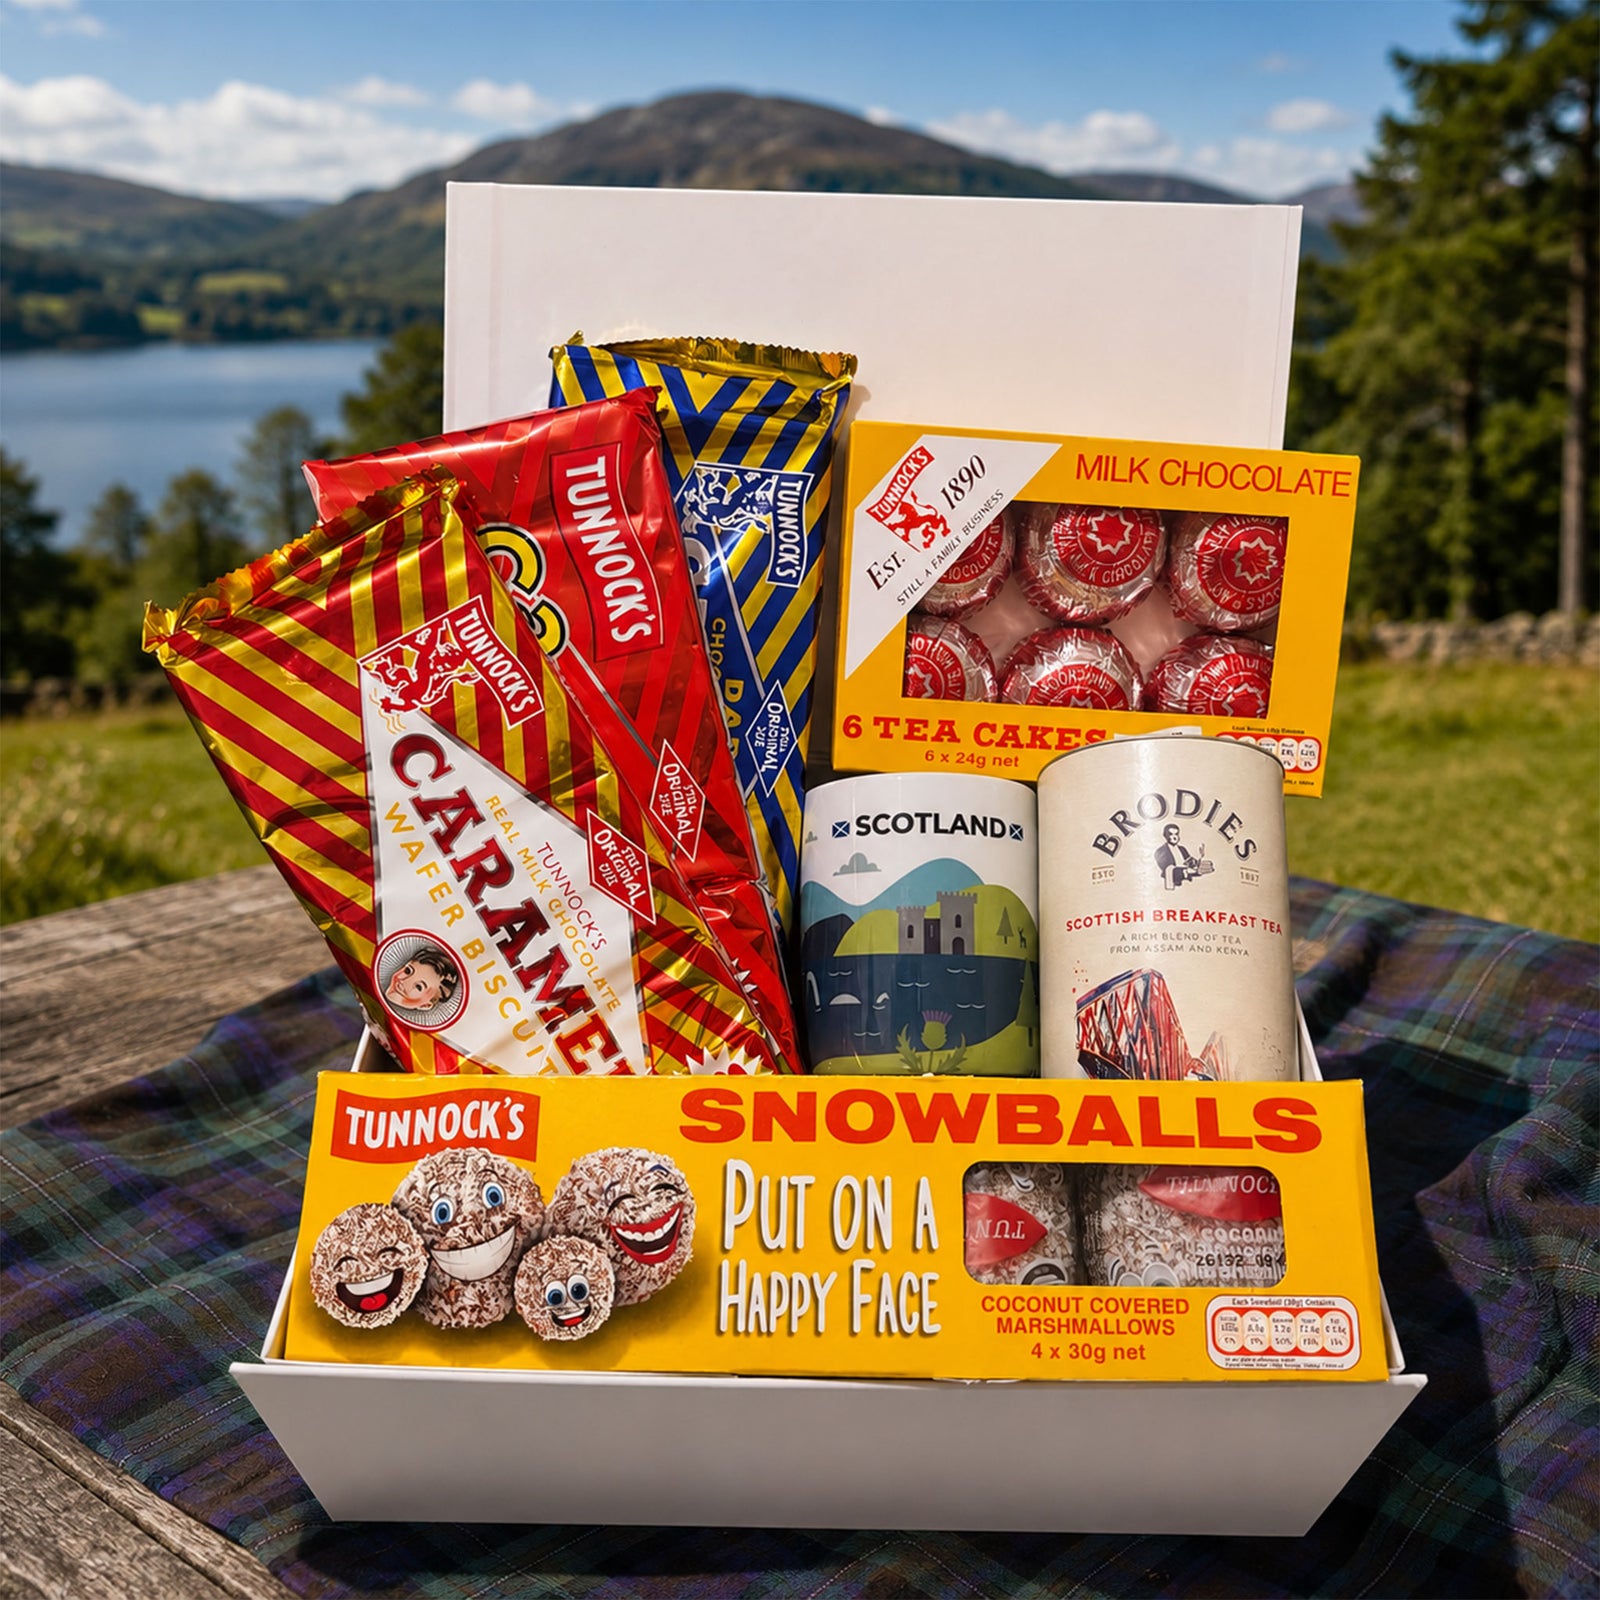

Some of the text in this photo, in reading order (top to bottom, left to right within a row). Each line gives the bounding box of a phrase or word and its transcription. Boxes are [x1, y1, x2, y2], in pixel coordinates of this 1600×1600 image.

[872, 451, 928, 521] TUNNOCK'S
[940, 454, 986, 510] 1890
[1076, 453, 1352, 497] MILK CHOCOLATE
[565, 455, 657, 643] TUNNOCK'S
[776, 479, 803, 579] TUNNOCK'S
[897, 577, 924, 606] STILL
[963, 489, 1005, 536] BUSINESS
[455, 607, 536, 714] TUNNOCK'S
[842, 714, 1106, 751] 6 TEA CAKES
[925, 750, 1019, 768] 6 x 24g net
[855, 812, 1006, 839] SCOTLAND
[1092, 788, 1258, 862] BRODIES
[384, 801, 465, 928] WAFER
[538, 842, 608, 951] TUNNOCK'S
[390, 733, 636, 1075] CARAME
[485, 795, 521, 844] REAL
[517, 848, 552, 893] MILK
[548, 898, 621, 1014] CHOCOLATE
[1066, 909, 1283, 936] SCOTTISH BREAKFAST TEA
[1110, 944, 1250, 957] FROM ASSAM AND KENYA
[1120, 932, 1242, 945] A RICH BLEND OF TEA
[345, 1096, 526, 1149] TUNNOCK'S
[679, 1088, 1322, 1153] SNOWBALLS
[722, 1158, 940, 1251] PUT ON A
[719, 1258, 943, 1335] HAPPY FACE
[981, 1295, 1190, 1315] COCONUT COVERED
[996, 1318, 1176, 1336] MARSHMALLOWS
[1031, 1343, 1146, 1364] 4 x 30g net
